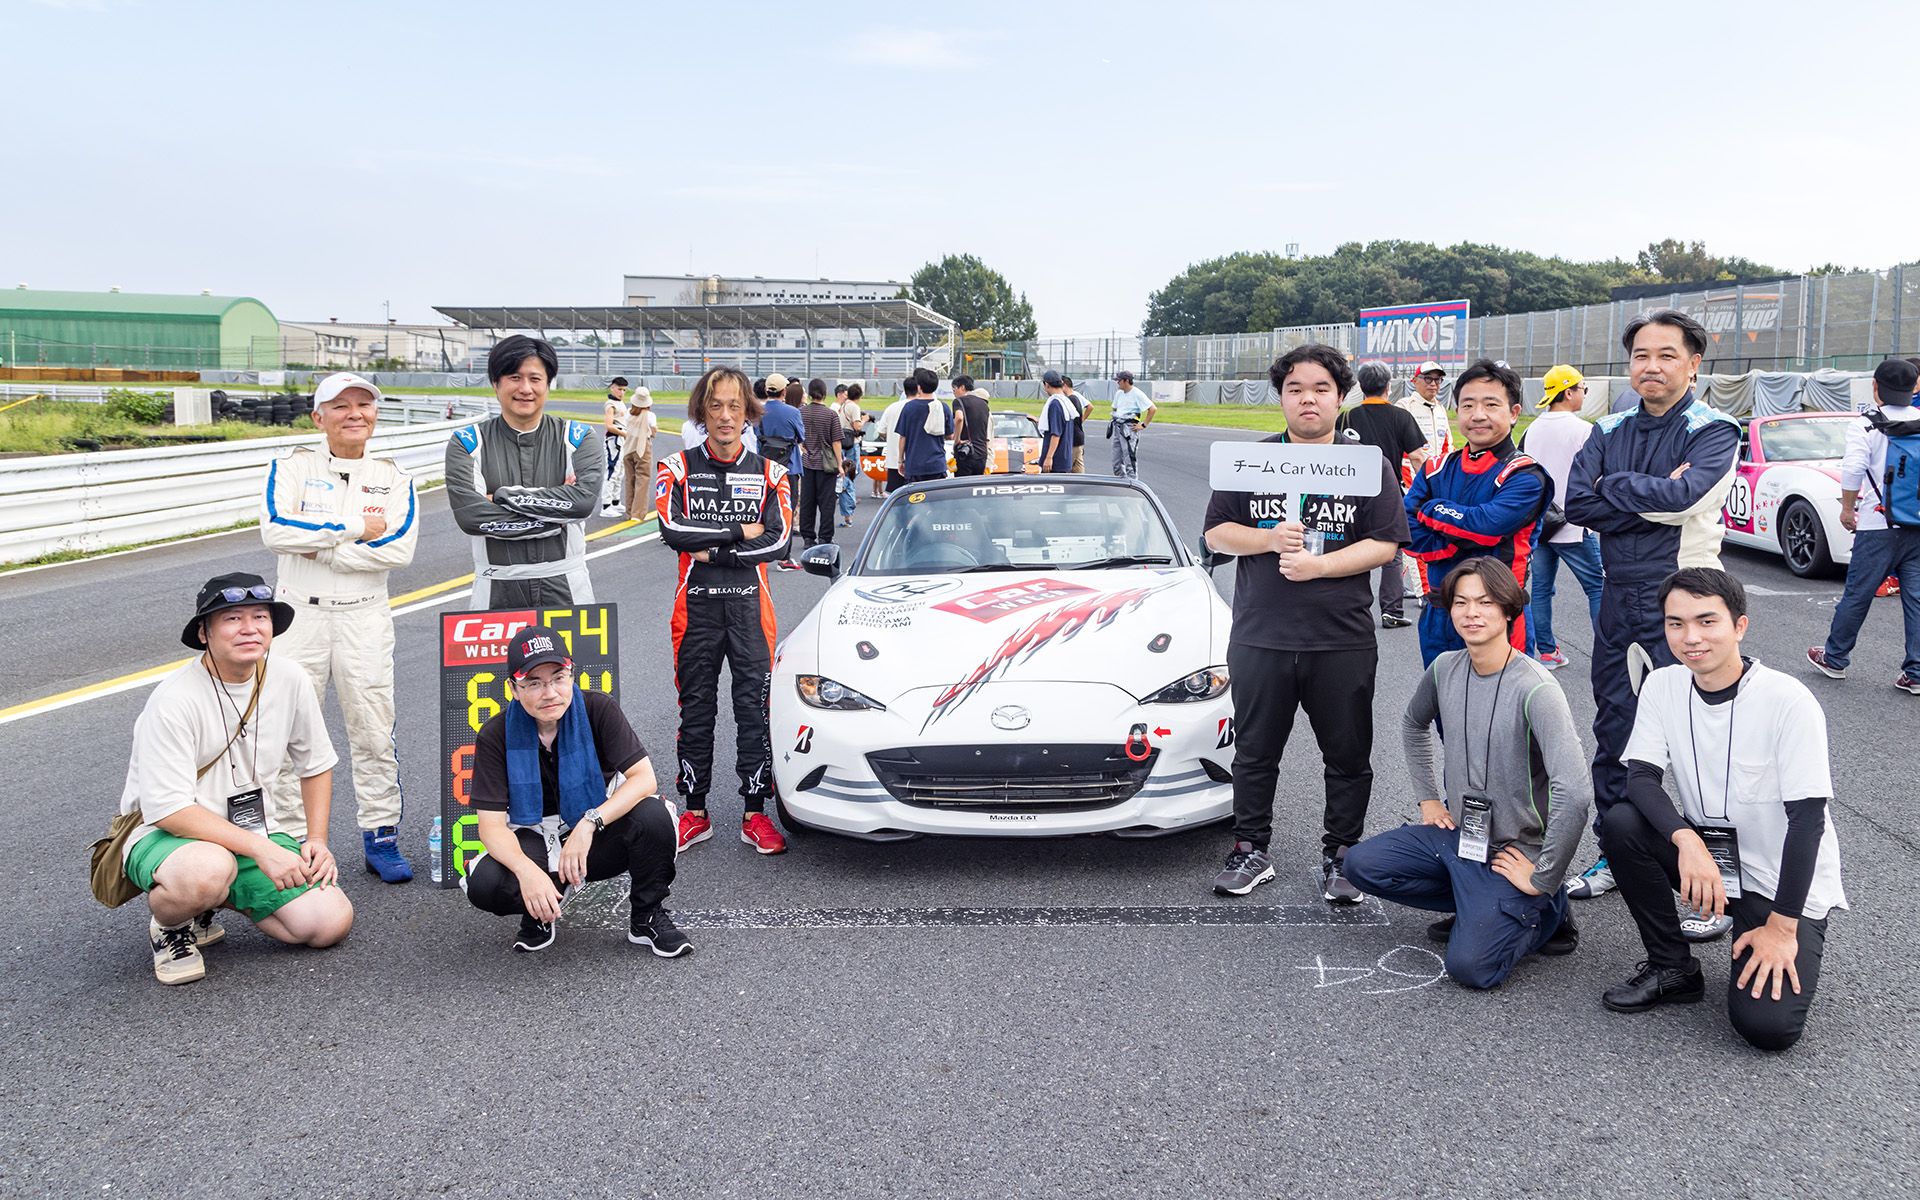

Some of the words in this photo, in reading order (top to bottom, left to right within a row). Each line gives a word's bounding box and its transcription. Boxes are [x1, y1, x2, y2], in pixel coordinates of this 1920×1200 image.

[1719, 302, 1749, 310] motr
[1366, 314, 1458, 354] WAKO'S
[1233, 459, 1276, 474] チーム
[1280, 462, 1306, 475] Car
[1310, 463, 1356, 477] Watch
[972, 485, 1065, 496] mazda
[690, 498, 759, 514] MAZDA
[691, 512, 757, 522] MOTORSPORTS
[932, 522, 973, 532] BRIDE
[1316, 522, 1334, 532] 5TH
[1335, 523, 1346, 533] ST
[954, 582, 1049, 610] Car
[990, 589, 1069, 611] Watch
[453, 618, 528, 643] Car
[464, 644, 508, 658] Watc
[521, 634, 553, 655] Brains
